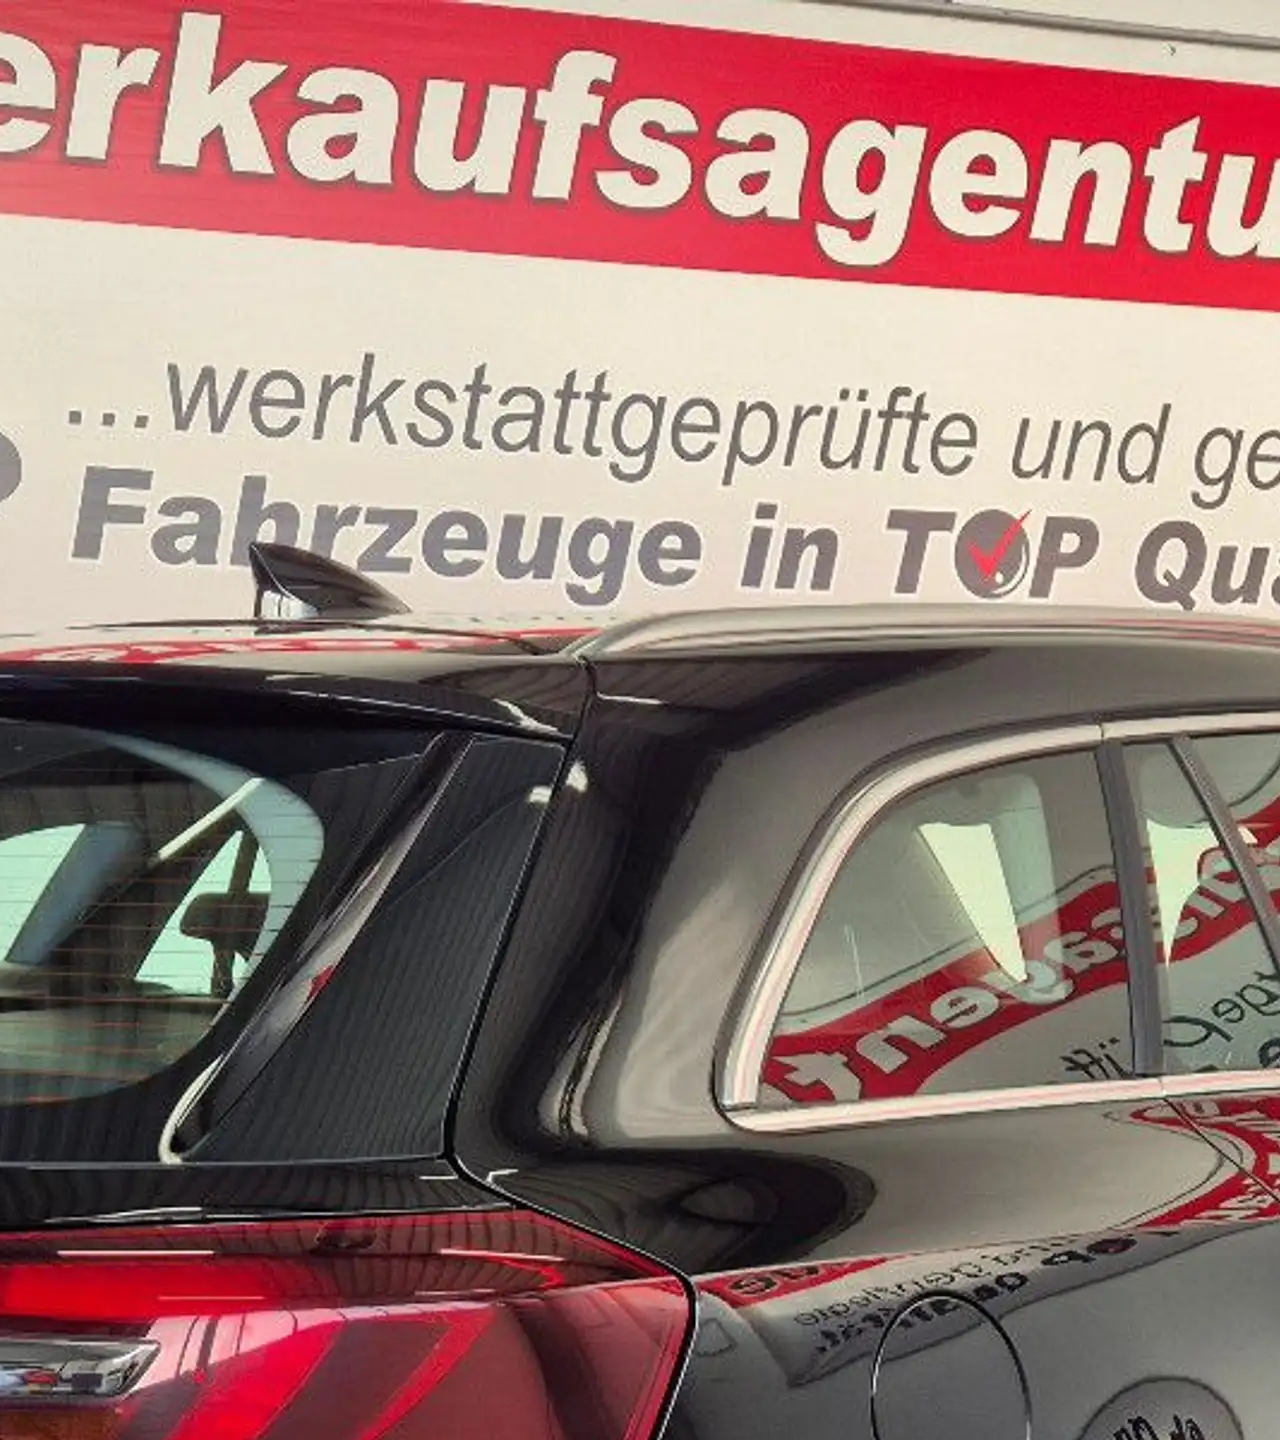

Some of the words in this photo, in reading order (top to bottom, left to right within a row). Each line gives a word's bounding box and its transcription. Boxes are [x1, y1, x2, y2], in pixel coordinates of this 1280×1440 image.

[1011, 405, 1171, 485] und
[70, 466, 702, 607] Fahrzeuge
[740, 504, 840, 591] in
[886, 508, 1100, 600] TOP
